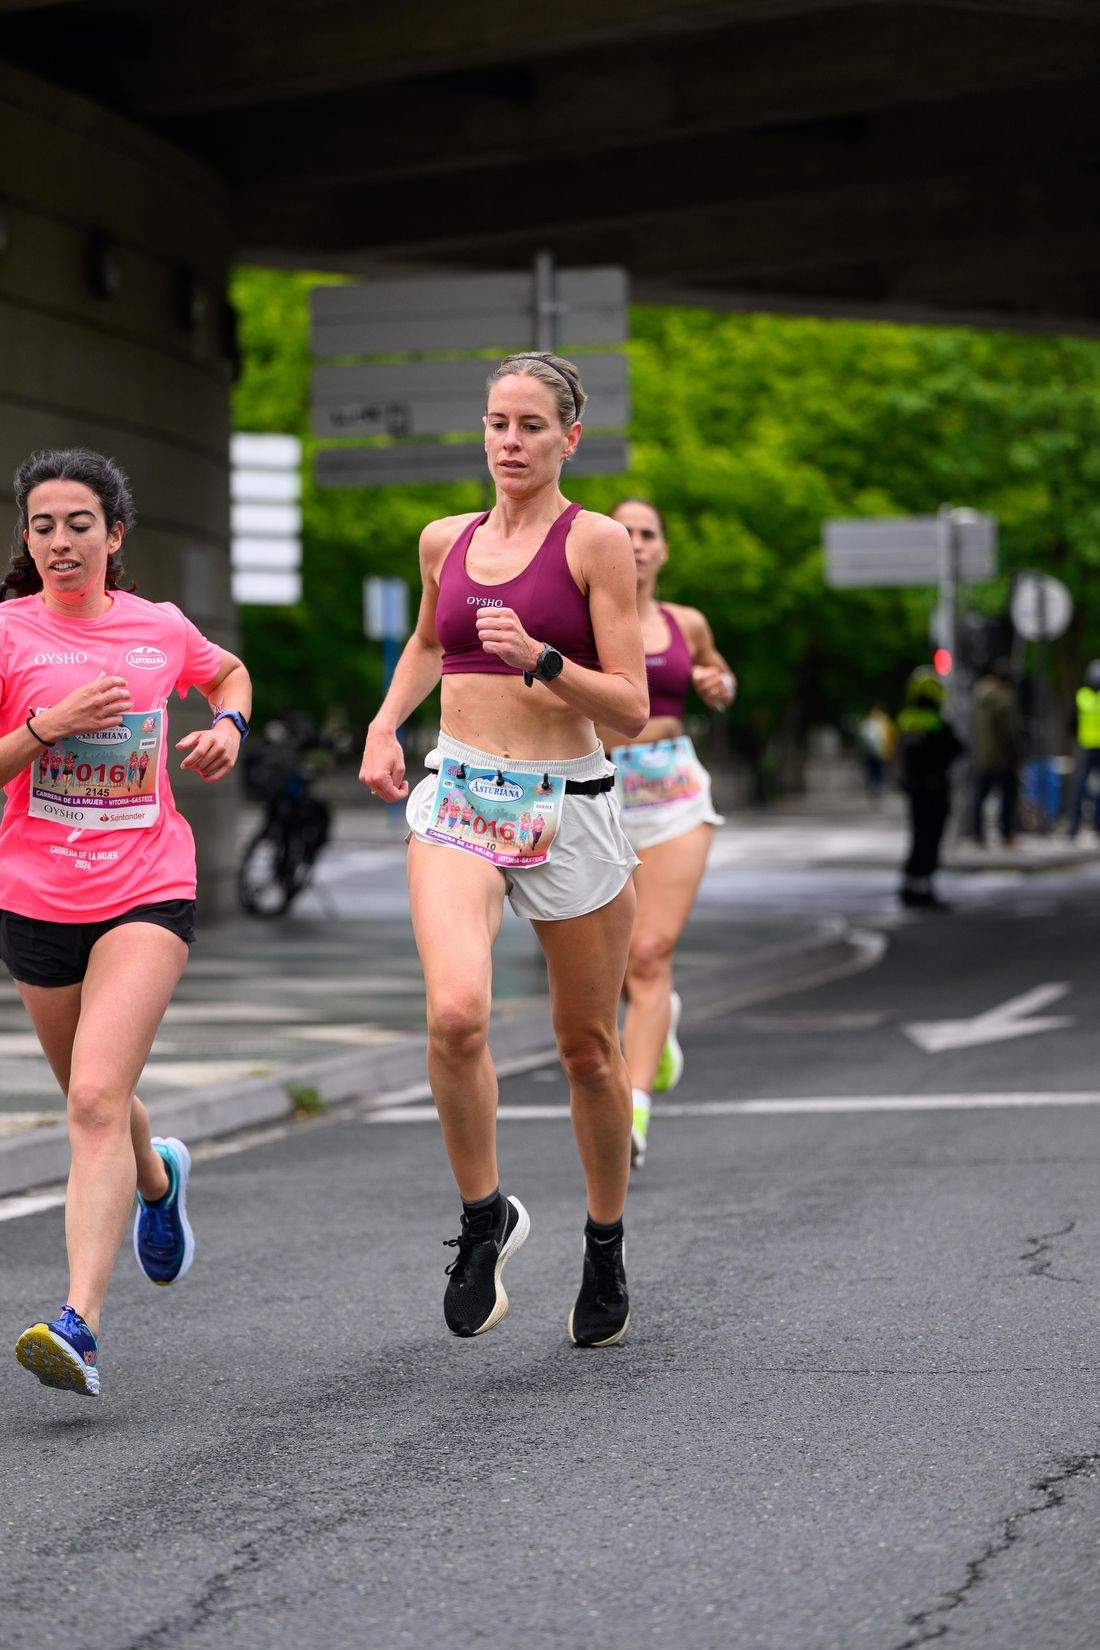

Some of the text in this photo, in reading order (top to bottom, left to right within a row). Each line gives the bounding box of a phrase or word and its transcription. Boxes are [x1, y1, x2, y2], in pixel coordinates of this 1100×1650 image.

[466, 596, 503, 607] OYSHO
[34, 651, 88, 665] OYSHO
[75, 763, 125, 783] 016
[35, 790, 62, 802] CARRERA
[82, 798, 104, 806] MUJER
[85, 787, 109, 797] 2145
[471, 781, 520, 799] ASTURIANA
[44, 804, 84, 821] OYSHO
[110, 812, 145, 822] Santander
[472, 815, 516, 841] 016
[429, 831, 456, 843] CARRERA
[466, 842, 474, 850] LA
[50, 845, 119, 861] CARRERA DE LA MUJER
